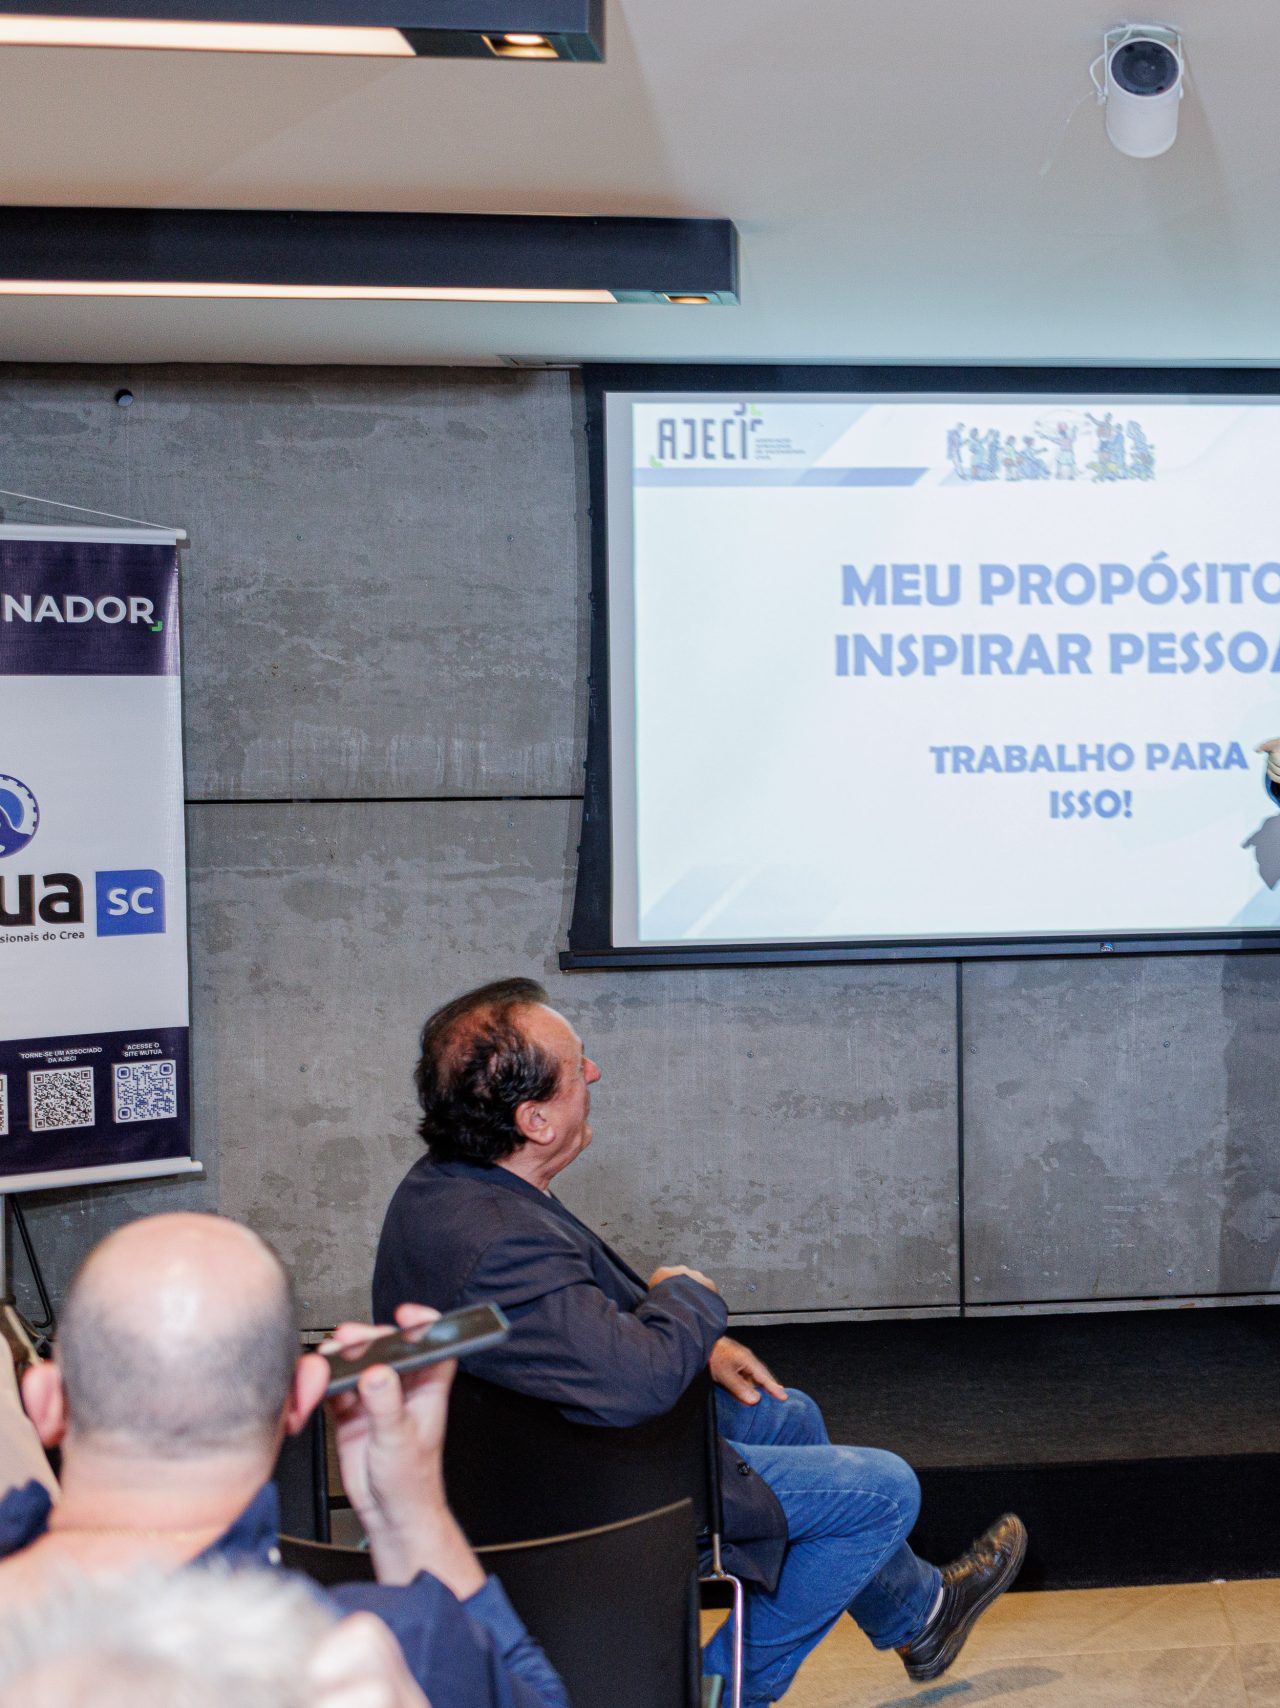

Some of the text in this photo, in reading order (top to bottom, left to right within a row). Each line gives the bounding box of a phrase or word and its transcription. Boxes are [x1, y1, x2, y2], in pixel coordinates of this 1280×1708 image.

[841, 563, 961, 607] MEU
[4, 593, 154, 624] NADOR
[835, 633, 1093, 677] INSPIRAR
[929, 741, 1249, 774] TRABALHO PARA
[1049, 789, 1133, 819] ISSO!
[42, 931, 57, 941] do
[60, 930, 85, 940] Crea
[20, 1051, 53, 1060] TORNE-SE
[65, 1047, 103, 1056] ASSOCIADO
